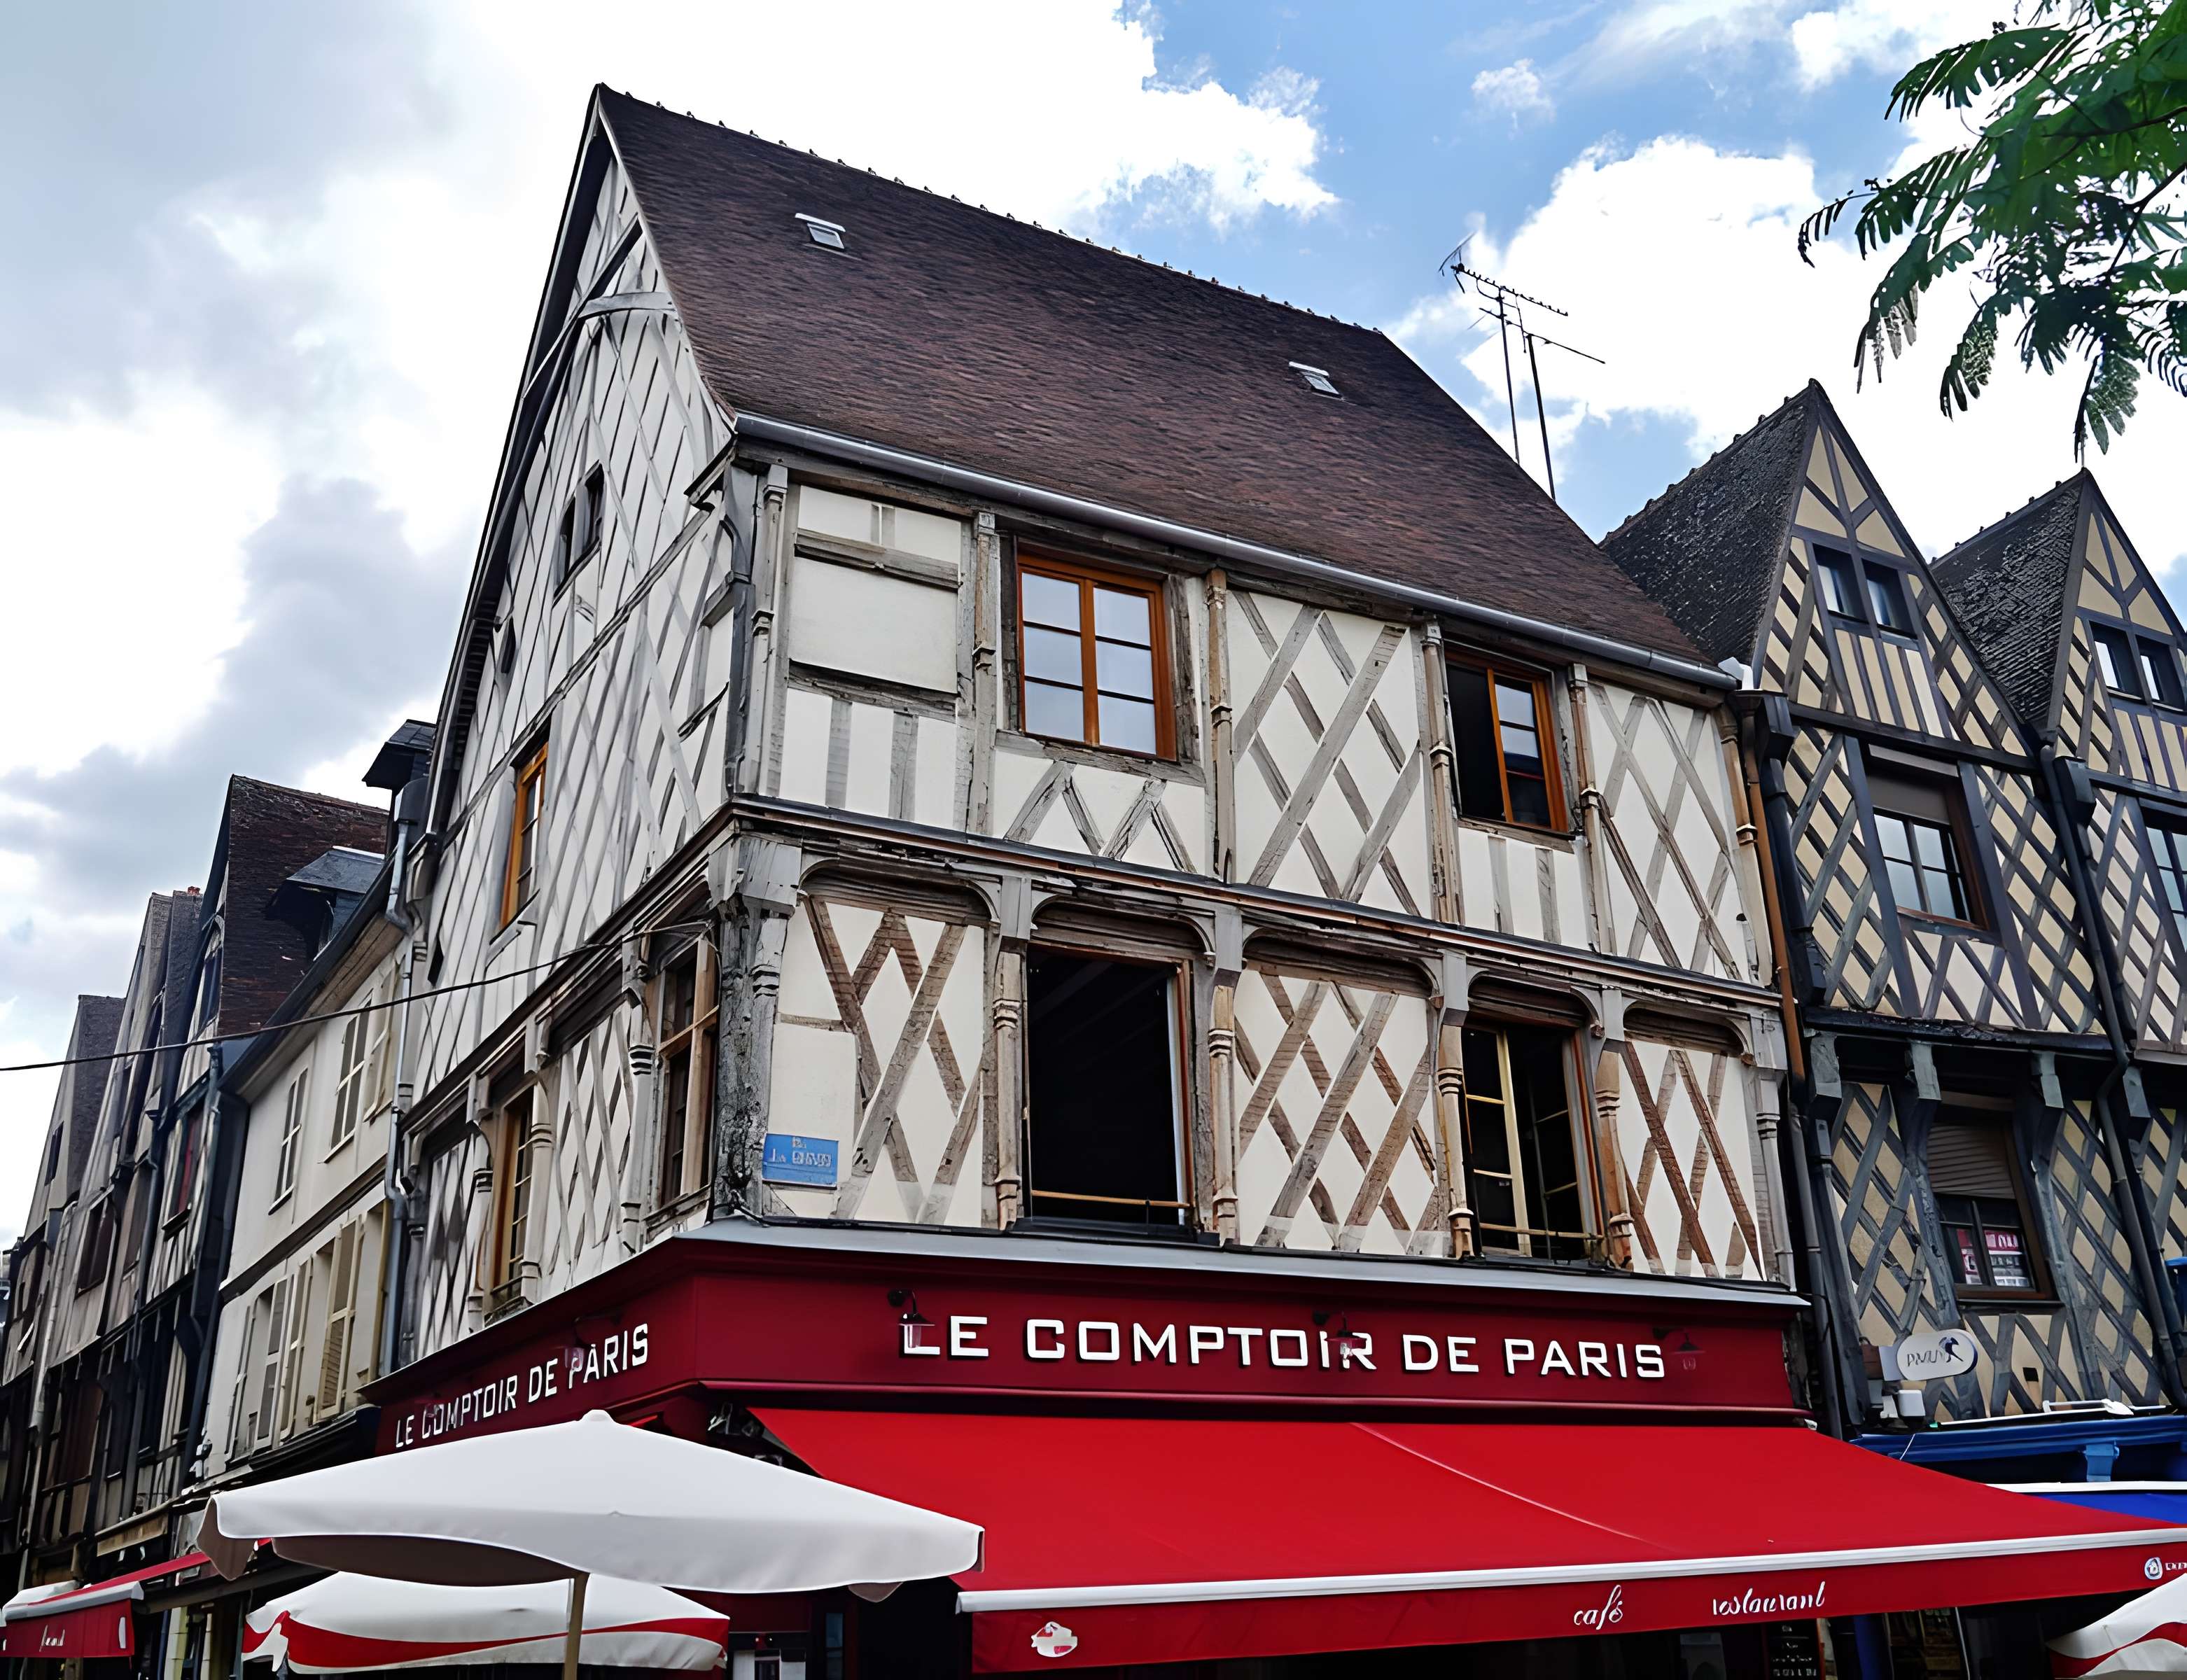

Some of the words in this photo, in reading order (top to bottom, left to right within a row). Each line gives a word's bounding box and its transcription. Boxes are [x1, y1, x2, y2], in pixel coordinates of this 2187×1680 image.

[904, 1315, 989, 1357] LE
[1027, 1319, 1378, 1370] COMPTOIR
[1402, 1334, 1479, 1373] DE
[1504, 1338, 1665, 1378] PARIS
[396, 1415, 415, 1448] LE
[421, 1375, 518, 1440] COMPTOIR
[528, 1358, 559, 1404] DE
[568, 1323, 648, 1390] PARIS
[1573, 1584, 1623, 1630] café
